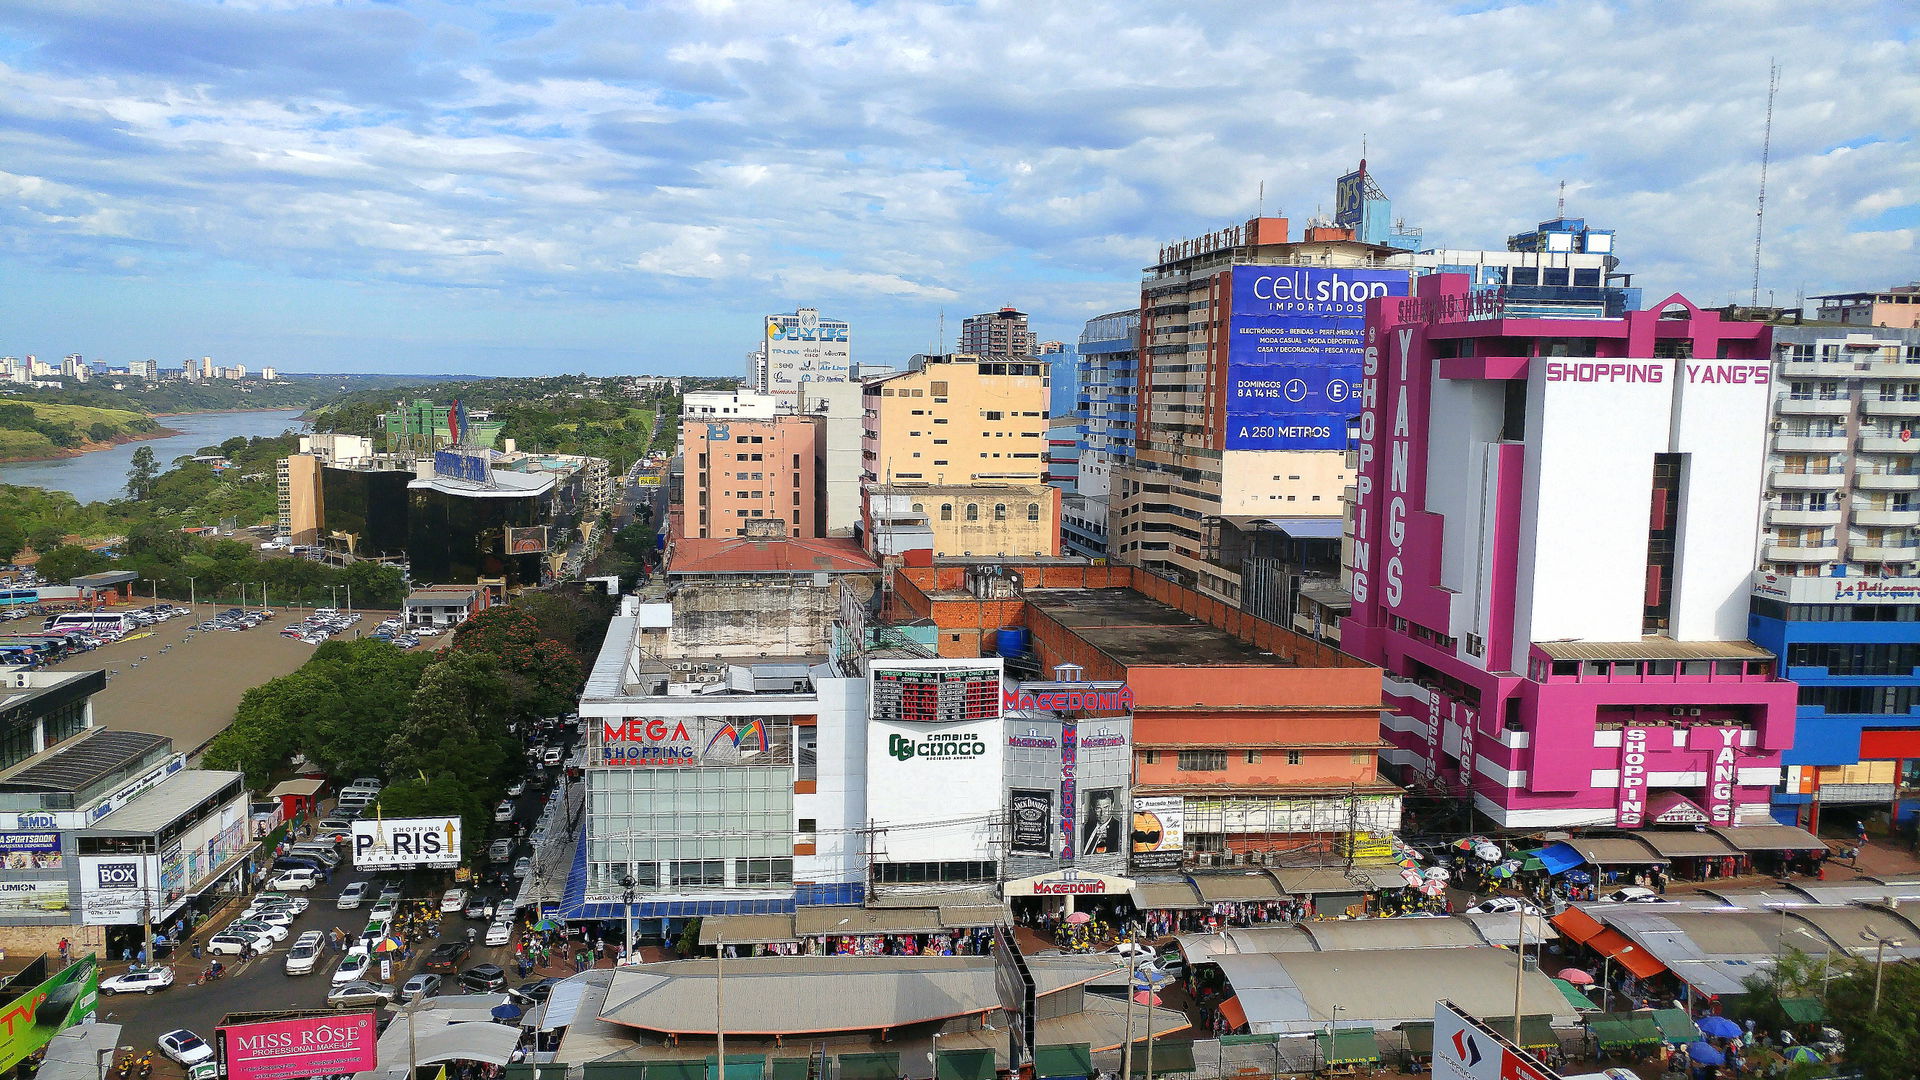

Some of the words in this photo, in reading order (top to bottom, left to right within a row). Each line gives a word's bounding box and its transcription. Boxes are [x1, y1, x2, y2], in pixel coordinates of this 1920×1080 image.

[1269, 303, 1364, 313] IMPORTADOS
[1280, 346, 1320, 354] DECORACIÓN
[1546, 363, 1664, 383] SHOPPING
[1686, 365, 1770, 385] YANG'S
[1237, 390, 1243, 398] 8
[1245, 390, 1252, 398] A
[1254, 390, 1265, 398] 14
[1266, 390, 1280, 398] HS.
[1239, 427, 1249, 438] A
[1251, 427, 1275, 438] 250
[1278, 427, 1331, 438] METROS
[1354, 346, 1378, 604] SHOPPING
[1002, 682, 1134, 712] MACEDONIA
[604, 719, 691, 742] MEGA
[926, 733, 979, 741] CAMBIOS
[1008, 735, 1057, 748] MACEDONIA
[1081, 734, 1126, 748] MACEDONIA
[603, 746, 694, 759] SHOPPING
[917, 742, 986, 757] CHACO
[604, 758, 694, 766] IMPORTADOS
[1621, 729, 1647, 825] SHOPPING
[1062, 726, 1077, 861] MACEDONIA
[6, 834, 53, 843] SPORTSBOOK
[357, 854, 442, 863] PARAGUAY
[99, 868, 136, 882] BOX
[1033, 879, 1106, 894] MACEDONIA
[237, 1032, 295, 1051] MISS
[300, 1024, 361, 1046] RÔSE
[251, 1044, 316, 1057] PROFESSIONAL
[316, 1041, 354, 1052] MAKE-UP
[1438, 1050, 1473, 1080] SHOPPING
